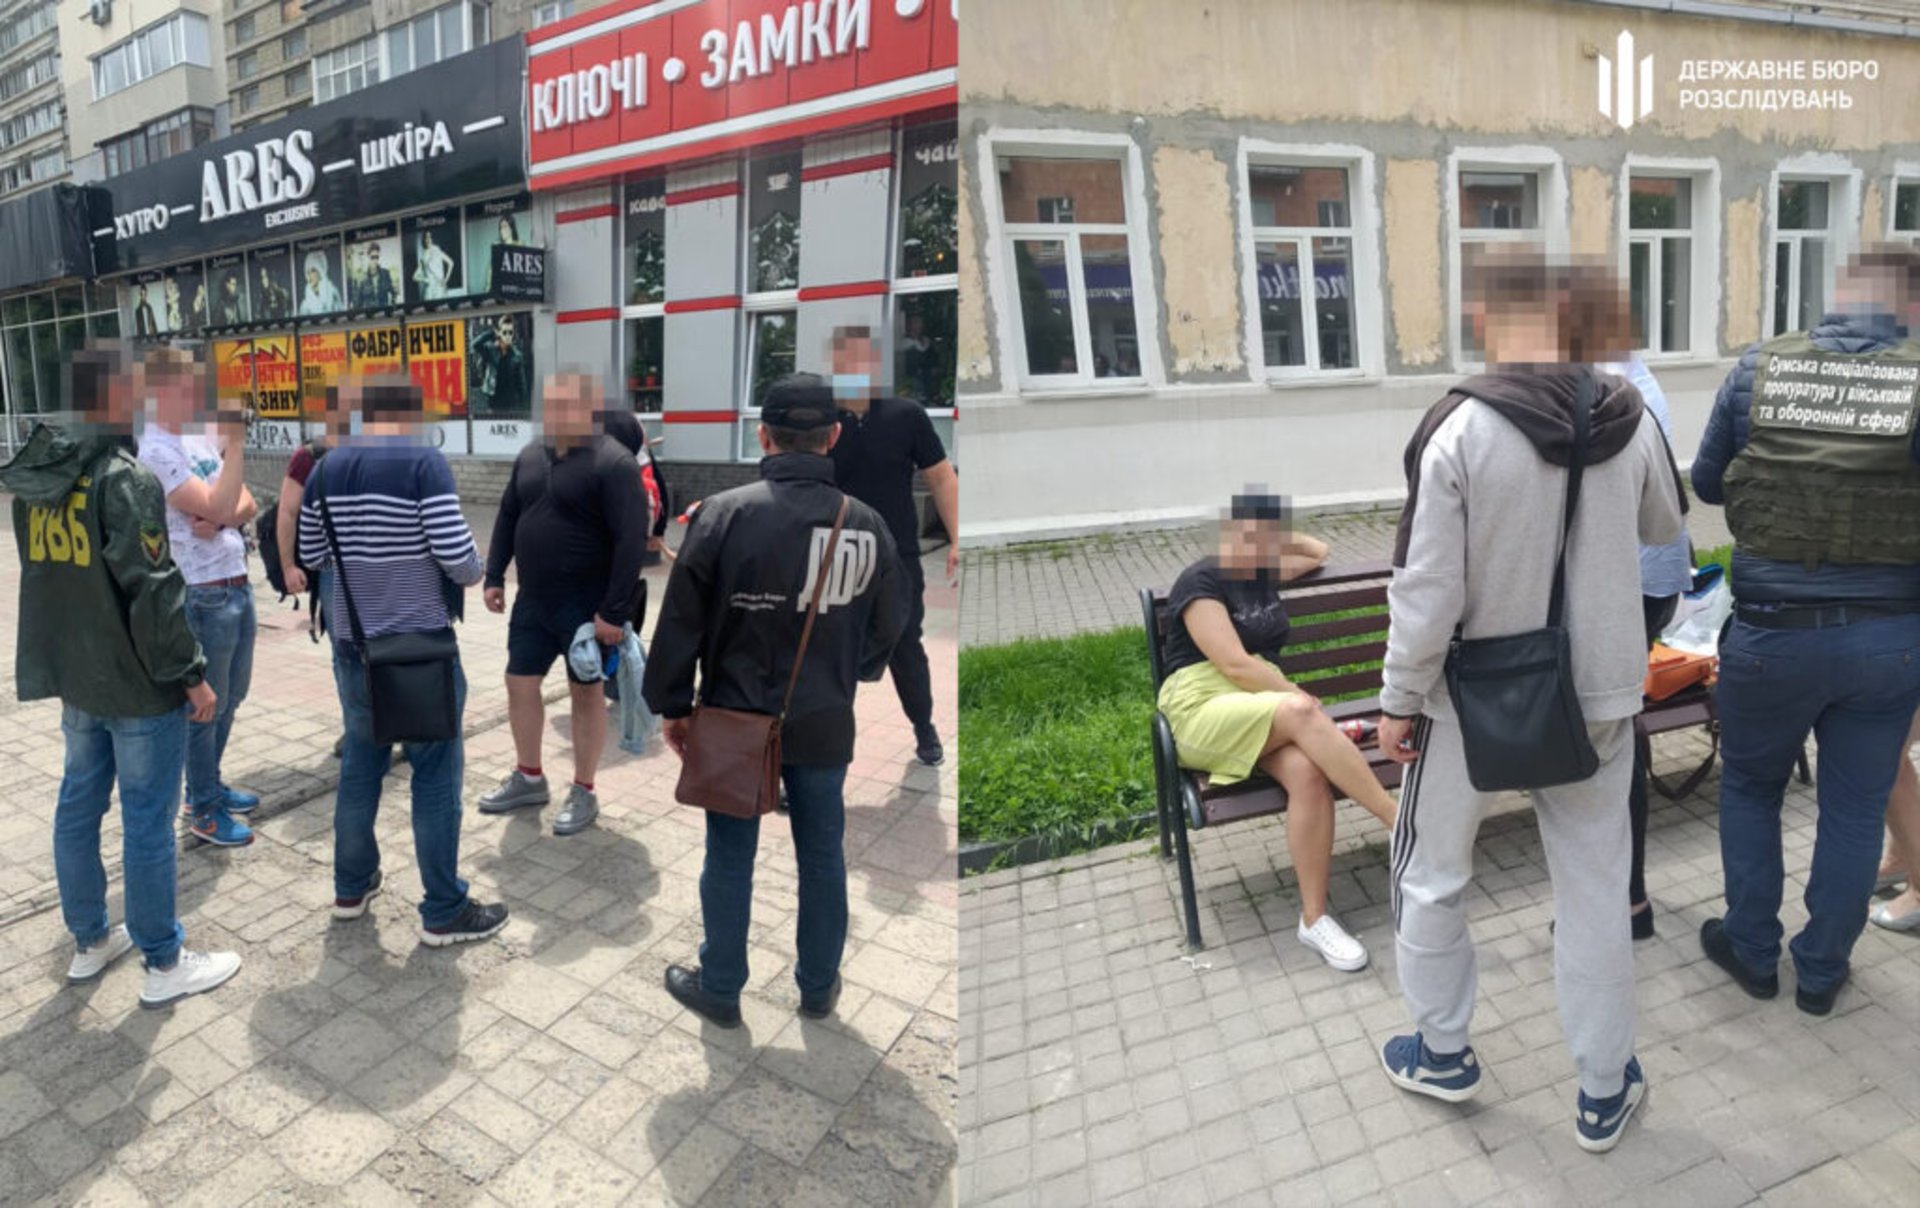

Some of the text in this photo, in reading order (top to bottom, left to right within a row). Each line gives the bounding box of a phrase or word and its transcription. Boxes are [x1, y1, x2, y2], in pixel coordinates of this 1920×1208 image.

[533, 0, 872, 132] КЛЮЧІ ЗАМКИ
[114, 203, 169, 241] ХУТРО
[199, 129, 316, 222] ARES
[500, 251, 544, 275] ARES
[352, 323, 455, 358] ФАБРИЧНІ
[1769, 356, 1919, 381] Сумська спеціалізована
[1763, 380, 1913, 405] прокуратура у військовій
[1759, 403, 1909, 433] та оборонній сфері
